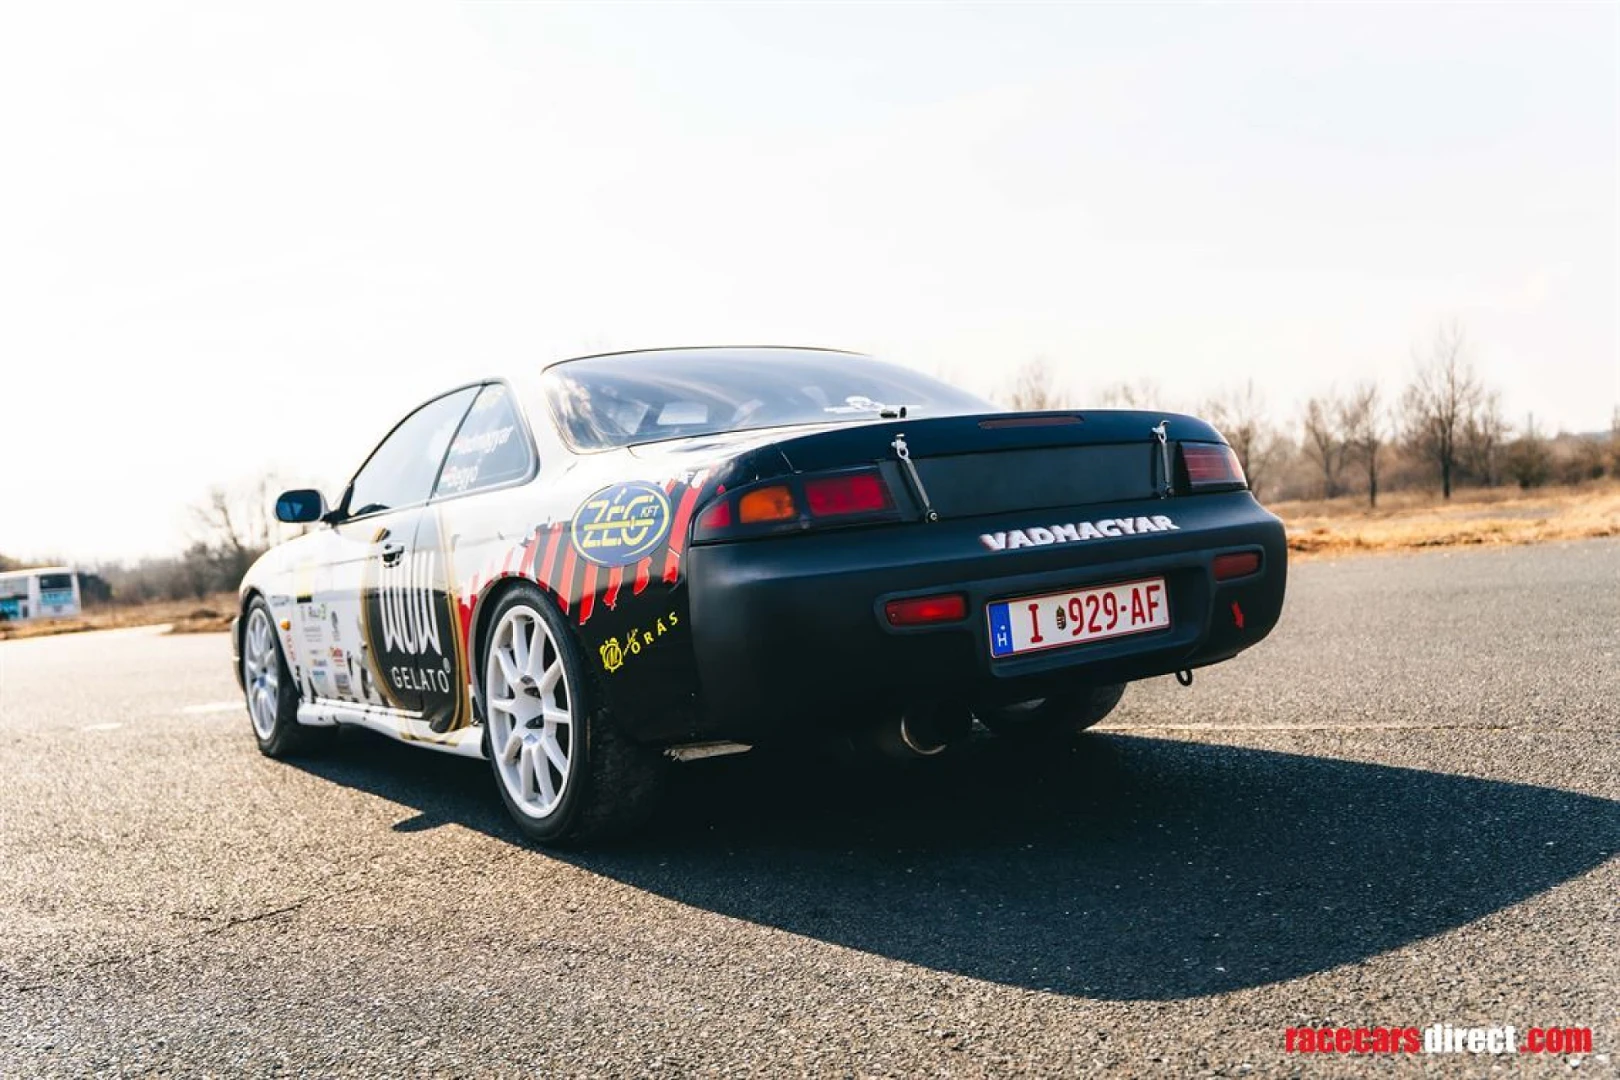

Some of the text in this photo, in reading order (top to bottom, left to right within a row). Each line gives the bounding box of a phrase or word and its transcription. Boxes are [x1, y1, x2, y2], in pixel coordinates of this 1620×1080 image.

[979, 515, 1180, 551] VADMAGYAR
[1028, 585, 1160, 643] I 929-AF
[997, 632, 1008, 647] H
[391, 666, 450, 693] GELATO
